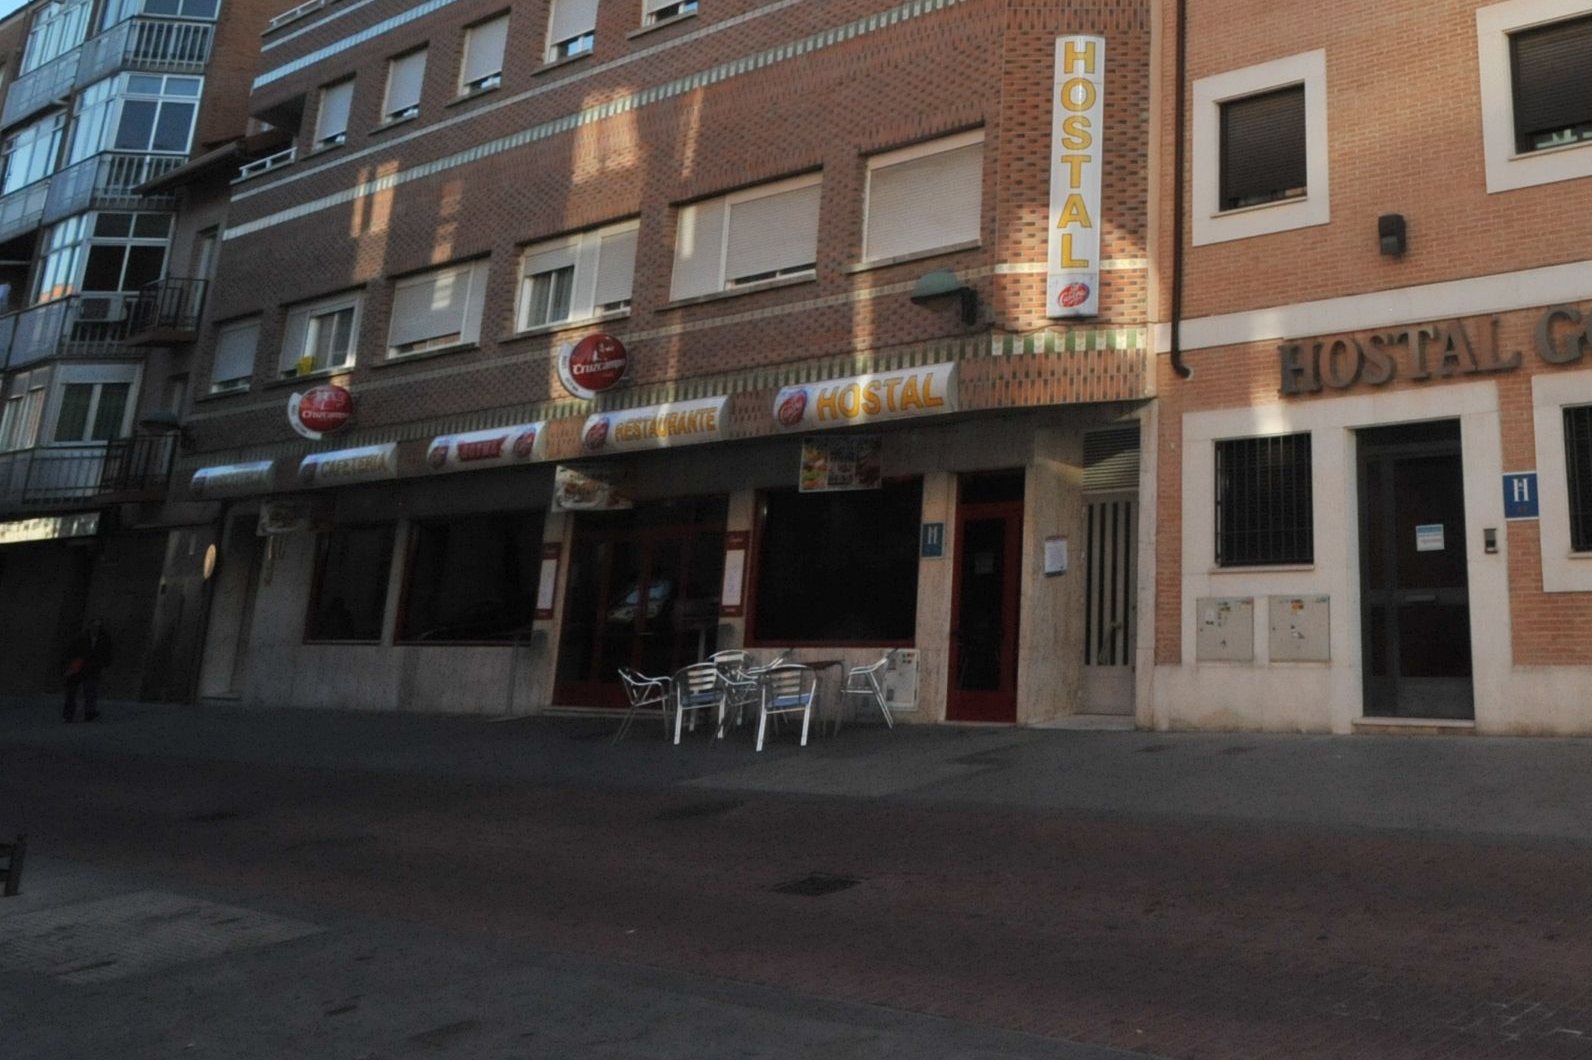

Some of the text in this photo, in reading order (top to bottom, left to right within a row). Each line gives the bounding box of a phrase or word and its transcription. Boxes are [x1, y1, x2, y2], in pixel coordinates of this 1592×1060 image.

[1056, 40, 1097, 270] HOSTAL
[1278, 316, 1523, 396] HOSTAL
[816, 372, 944, 421] HOSTAL
[614, 406, 718, 442] RESTAURANTE
[1512, 477, 1530, 503] H
